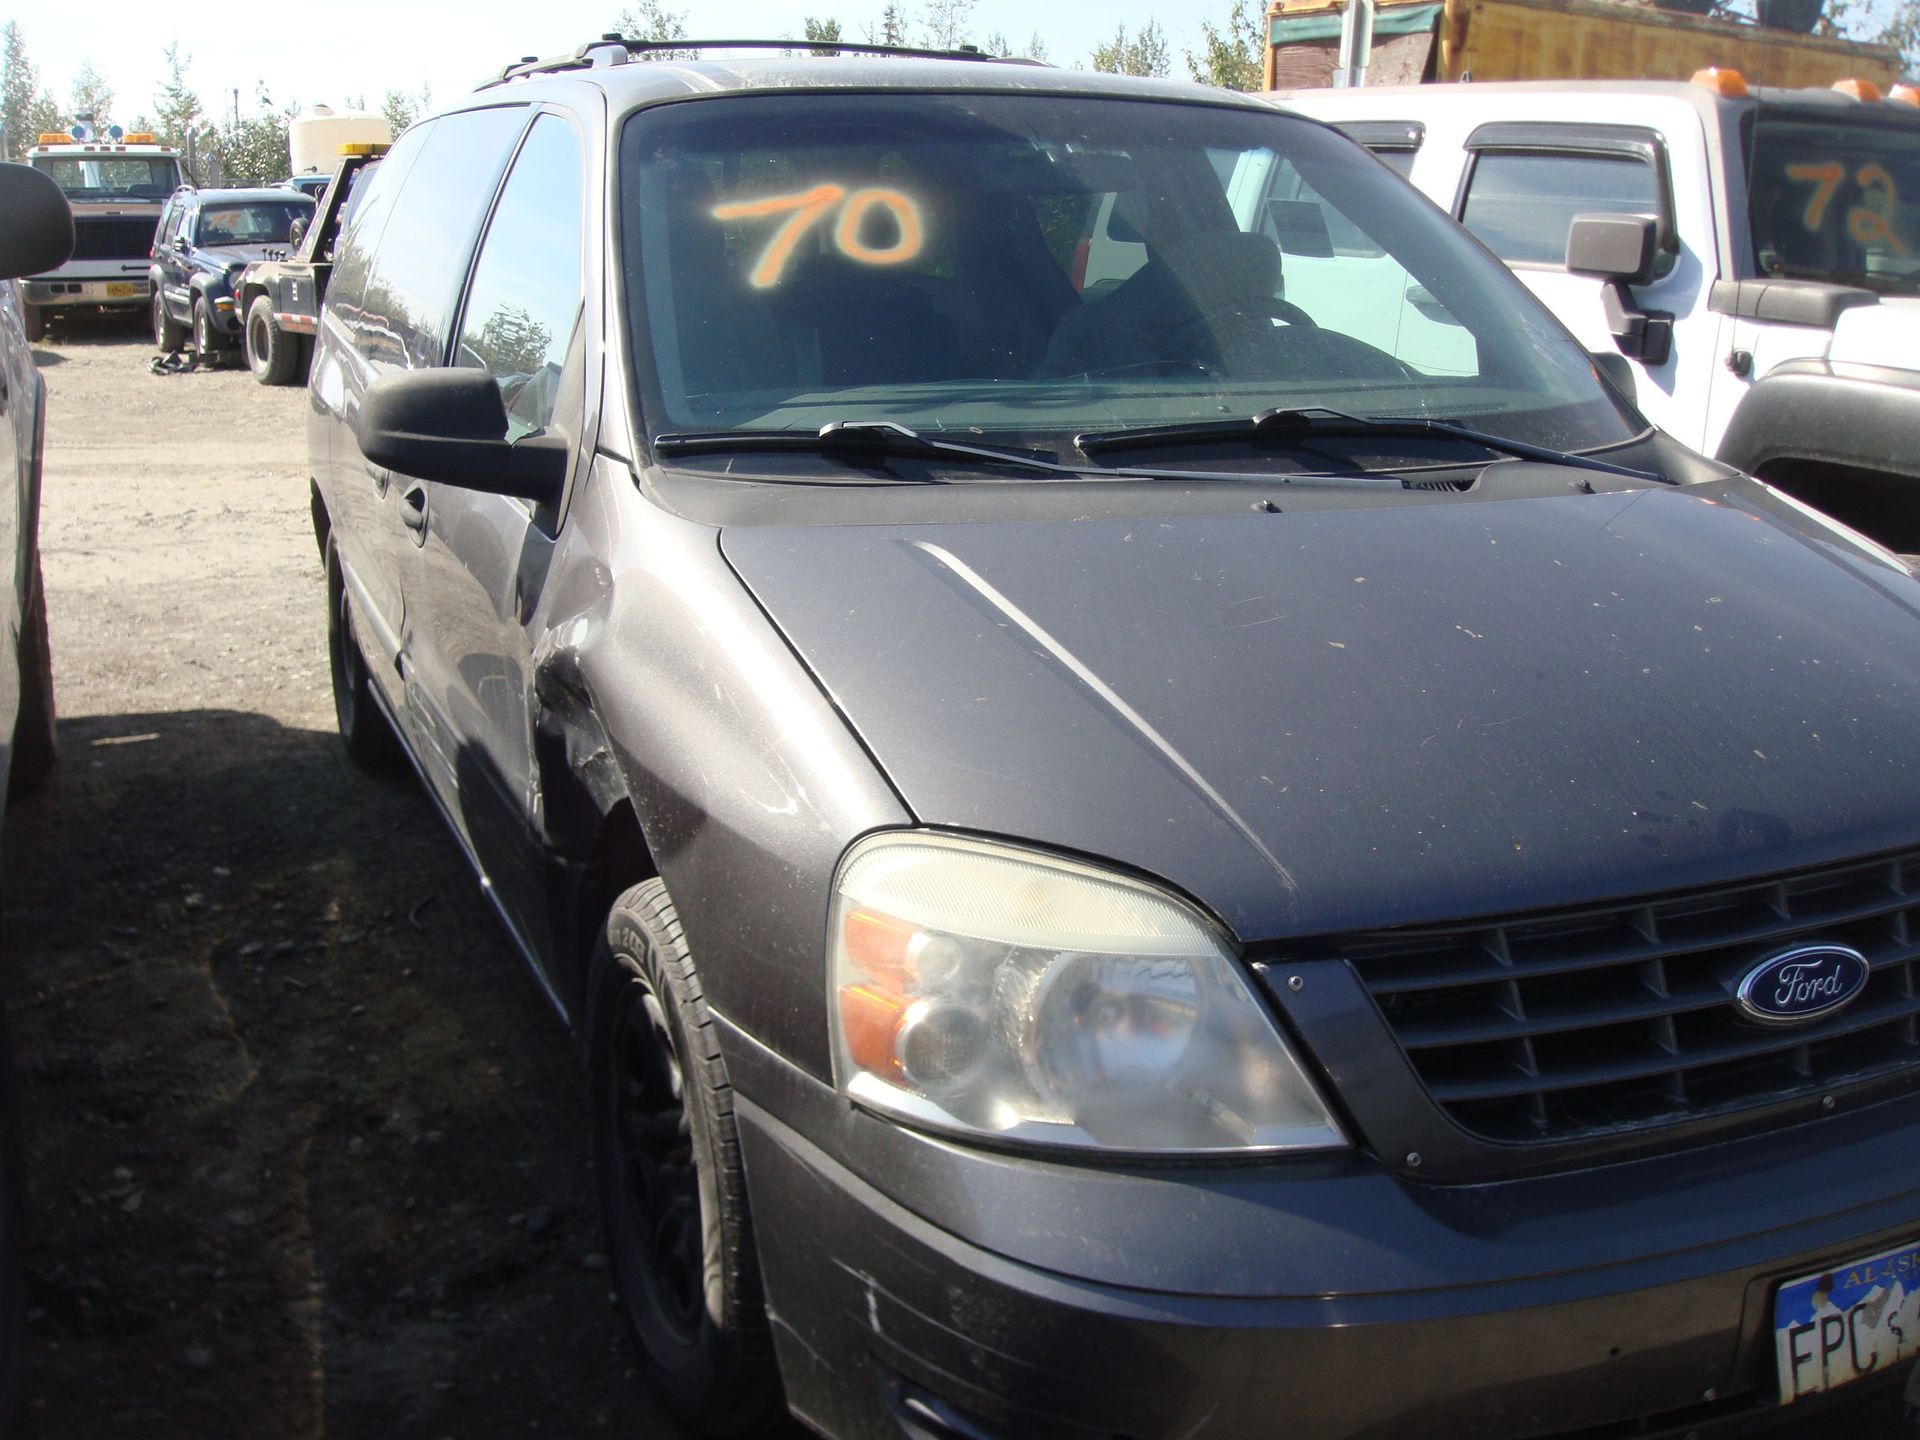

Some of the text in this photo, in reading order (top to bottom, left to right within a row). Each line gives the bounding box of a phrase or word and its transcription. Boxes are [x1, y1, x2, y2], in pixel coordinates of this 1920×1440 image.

[712, 183, 923, 289] 70
[1786, 162, 1907, 254] 72
[1774, 959, 1843, 1007] Ford
